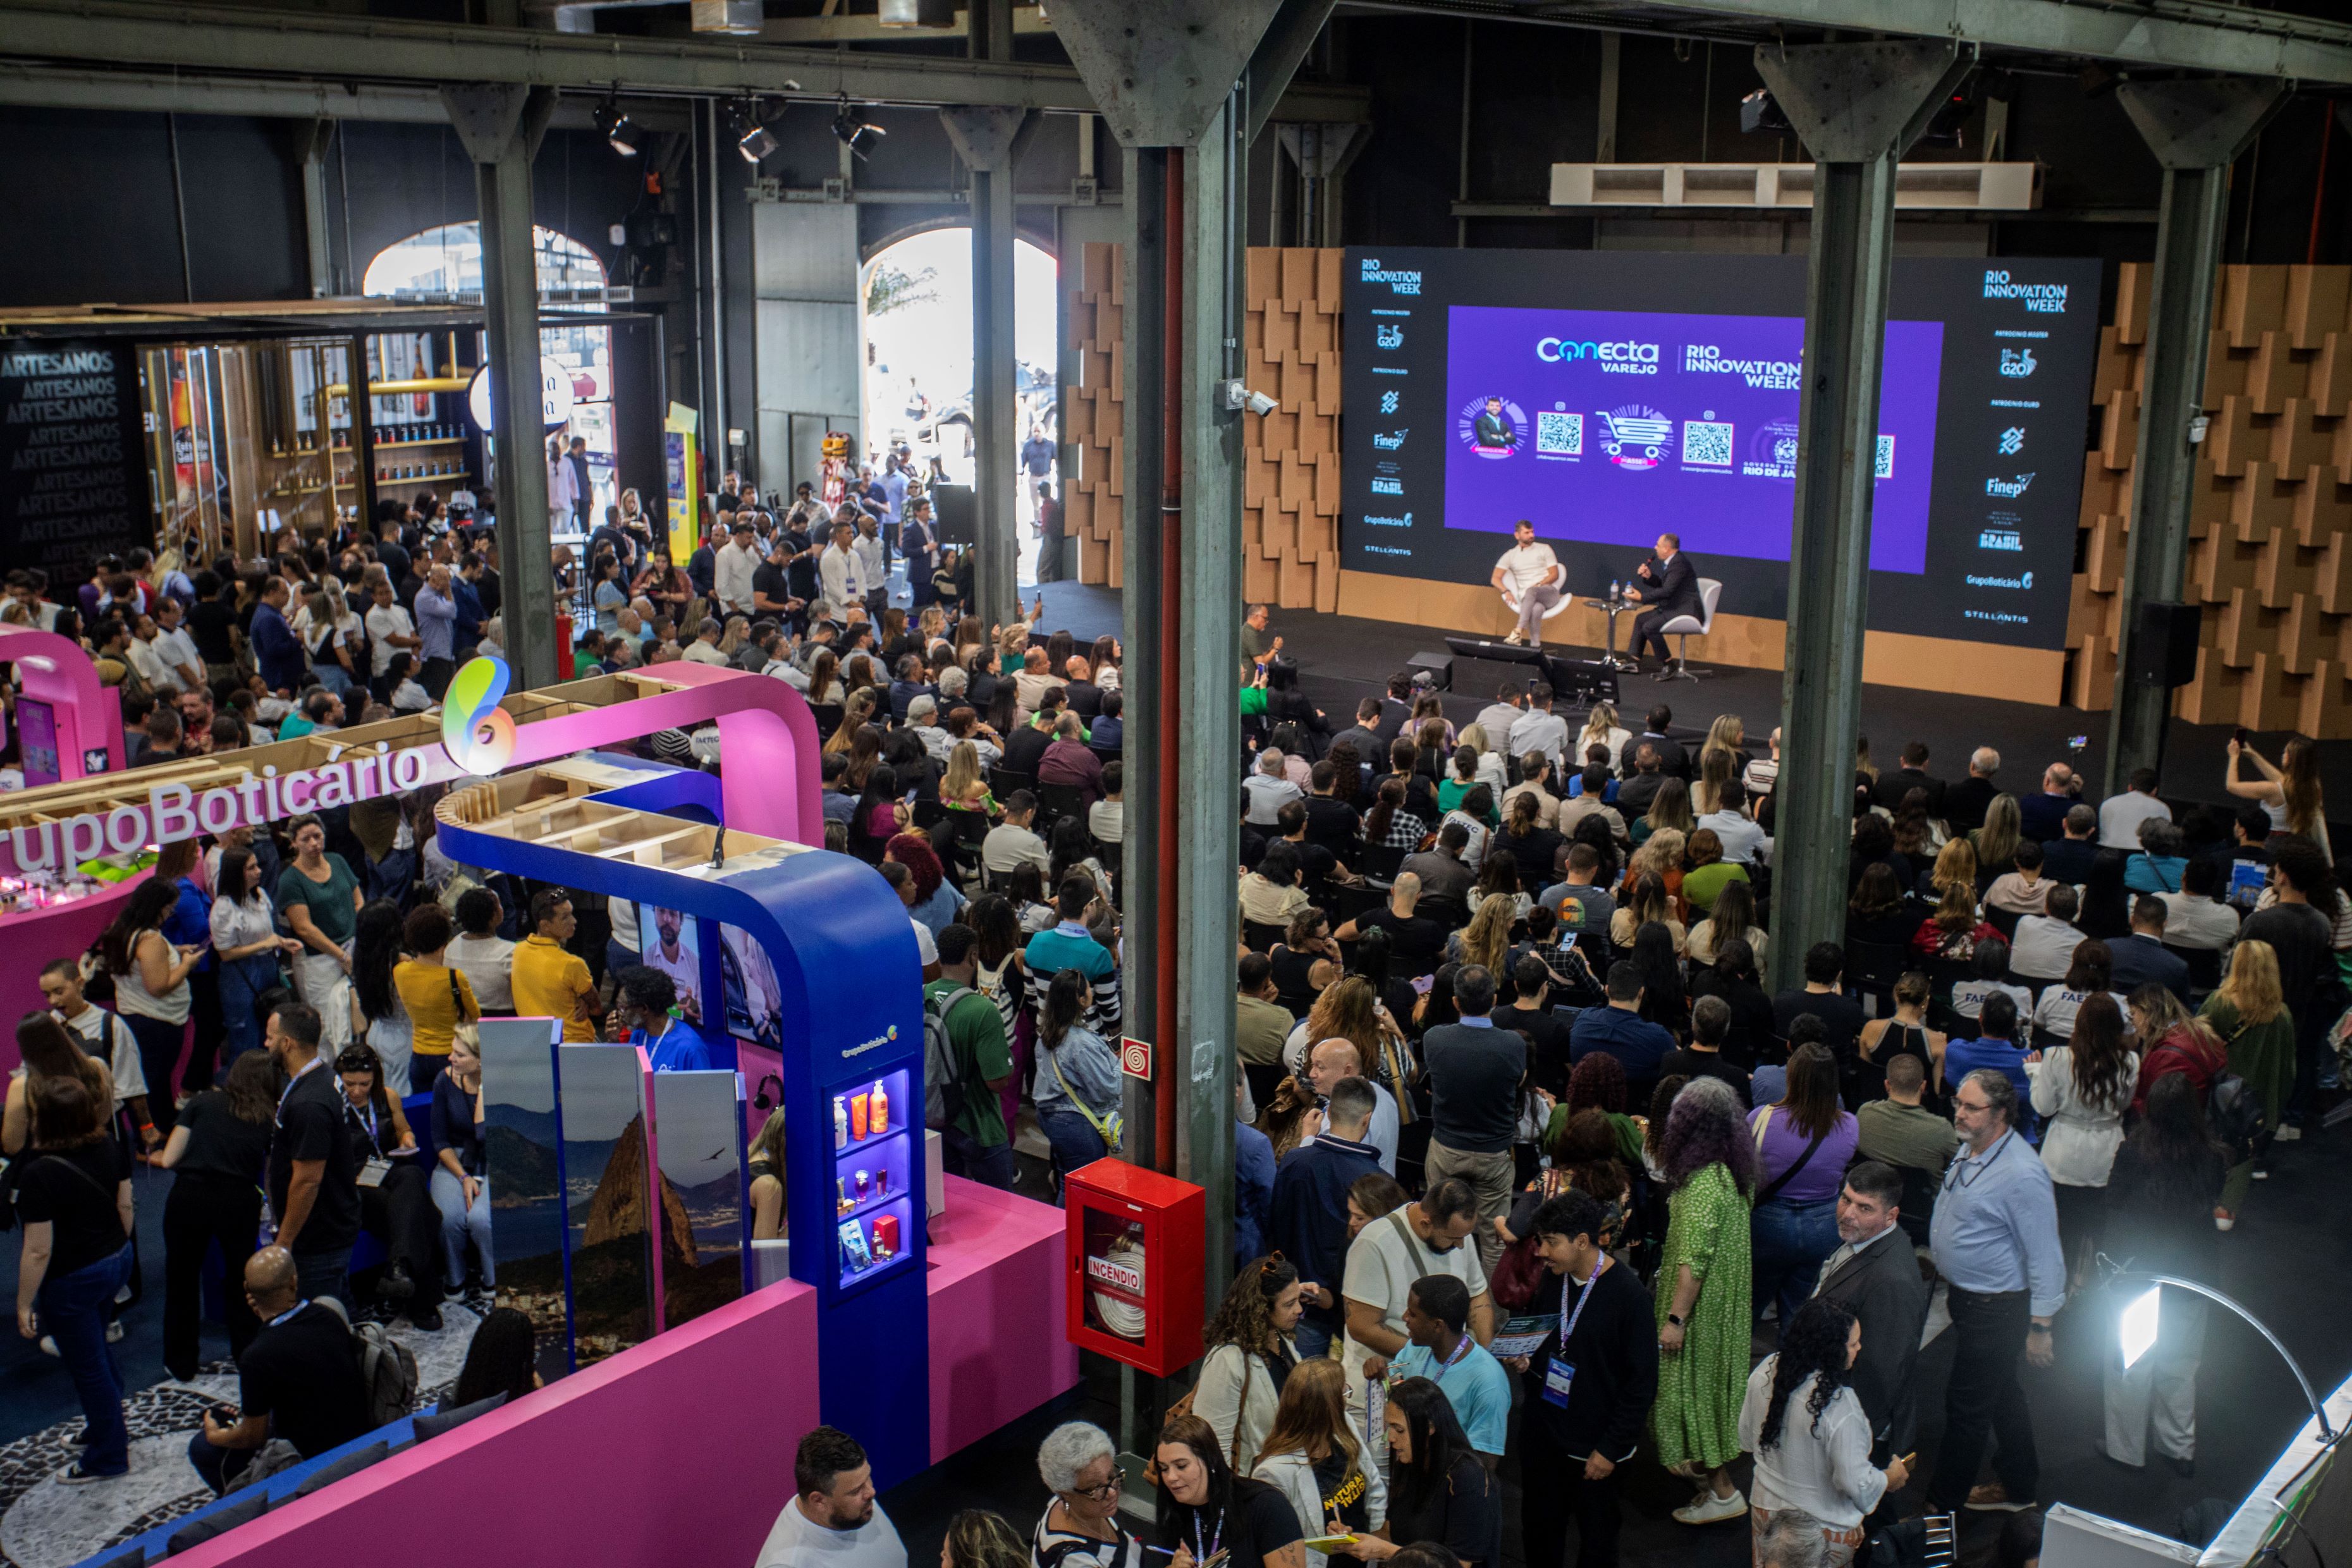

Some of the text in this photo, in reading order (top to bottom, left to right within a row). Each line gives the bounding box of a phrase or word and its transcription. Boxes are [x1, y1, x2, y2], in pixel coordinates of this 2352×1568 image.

[1362, 259, 1380, 271] RIO
[1361, 271, 1422, 283] INNOVATION
[1985, 270, 2010, 285] RIO
[1392, 283, 1421, 295] WEEK
[1983, 284, 2069, 299] INNOVATION
[2026, 298, 2067, 313] WEEK
[1377, 336, 1397, 348] G20
[1686, 345, 1720, 359] RIO
[1, 351, 115, 377] ARTESANOS
[1601, 362, 1658, 375] VAREJO
[1686, 358, 1802, 377] INNOVATION
[2000, 362, 2027, 376] G20
[22, 376, 117, 400] ARTESANOS
[1745, 374, 1801, 390] WEEK
[6, 396, 119, 424] ARTESANOS
[28, 422, 121, 446] ARTESANOS
[1374, 434, 1400, 450] Finep
[1743, 466, 1763, 475] RIO
[1765, 468, 1780, 477] DE
[1371, 480, 1404, 494] BRASIL
[1987, 477, 2023, 498] Finep
[1979, 533, 2023, 551] BRASIL
[1365, 545, 1411, 556] STELLANTIS
[1964, 610, 2028, 623] STELLANTIS
[1089, 1259, 1139, 1288] INCÊNDIO
